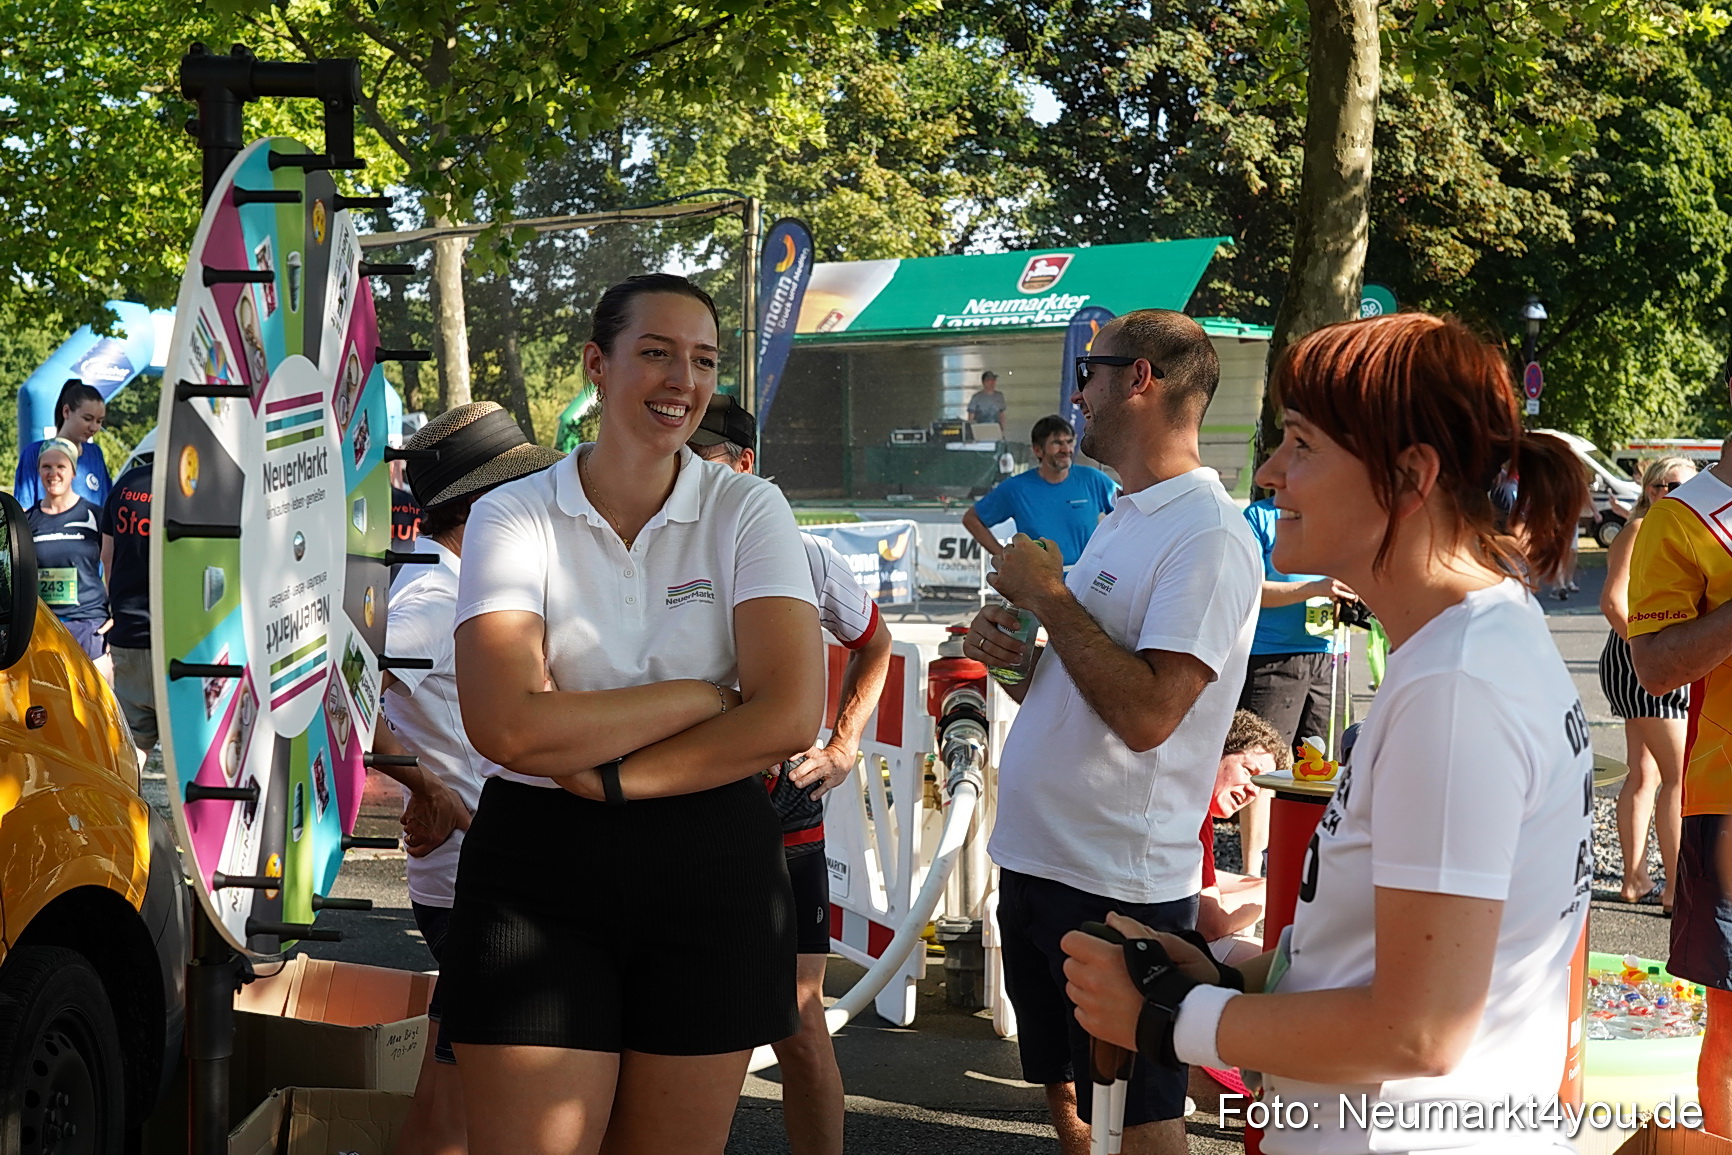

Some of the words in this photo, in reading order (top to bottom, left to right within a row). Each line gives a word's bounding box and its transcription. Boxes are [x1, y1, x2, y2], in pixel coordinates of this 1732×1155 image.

[789, 282, 799, 303] und
[962, 293, 1090, 315] Neumarkter
[263, 446, 328, 495] NeuerMarkt
[41, 581, 65, 593] 243
[666, 590, 716, 606] NeuerMarkt
[266, 594, 331, 655] NeuerMarkt
